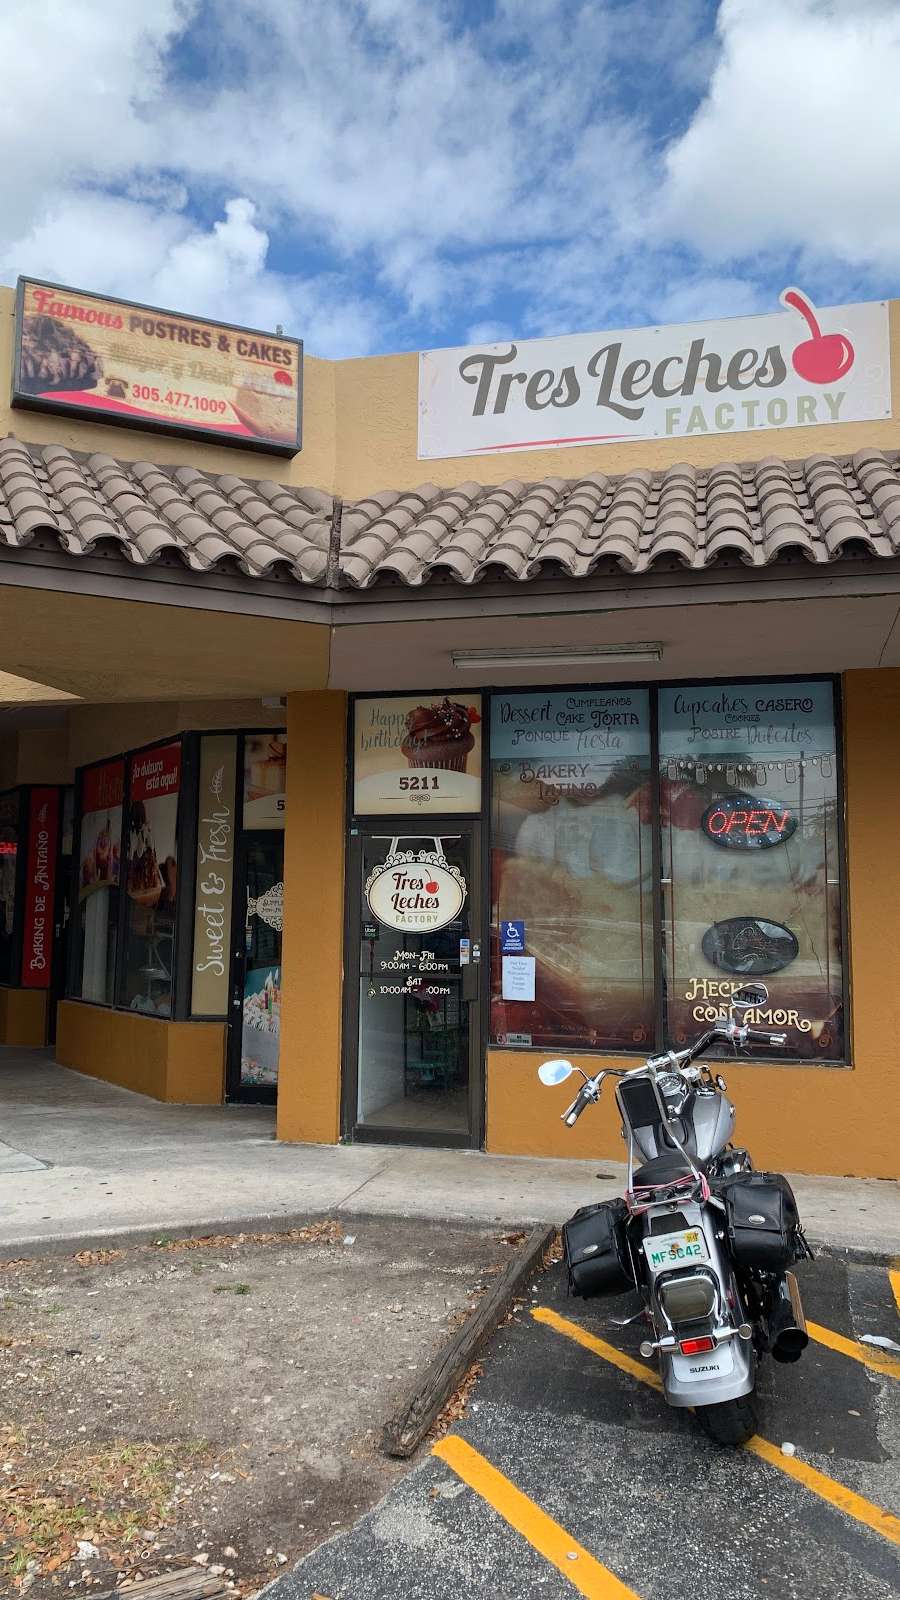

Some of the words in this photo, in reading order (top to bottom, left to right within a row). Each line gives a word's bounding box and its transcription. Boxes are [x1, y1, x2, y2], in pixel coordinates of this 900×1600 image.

[33, 289, 124, 330] Famous
[129, 315, 212, 349] POSTRES
[217, 335, 230, 352] &
[236, 339, 292, 366] CAKES
[458, 344, 581, 416] Tres
[587, 338, 787, 421] Leches
[131, 384, 227, 414] 305.477.1009
[664, 391, 846, 435] FACTORY
[500, 700, 553, 725] Dessert
[555, 711, 586, 726] CAKE
[590, 709, 640, 729] TORTA
[674, 692, 749, 727] Cupcakes
[755, 697, 814, 713] CASERO
[687, 726, 740, 744] POSTRE
[399, 776, 440, 791] 5211
[518, 760, 590, 783] BAKERY
[708, 809, 791, 834] OPEN
[200, 805, 232, 864] Fresh
[392, 871, 424, 890] Tres
[391, 893, 440, 914] Leches
[395, 915, 438, 923] FACTORY
[30, 917, 47, 969] BAKING
[196, 904, 224, 976] Sweet
[742, 1008, 812, 1032] AMOR
[689, 1365, 720, 1373] SUZUKI
